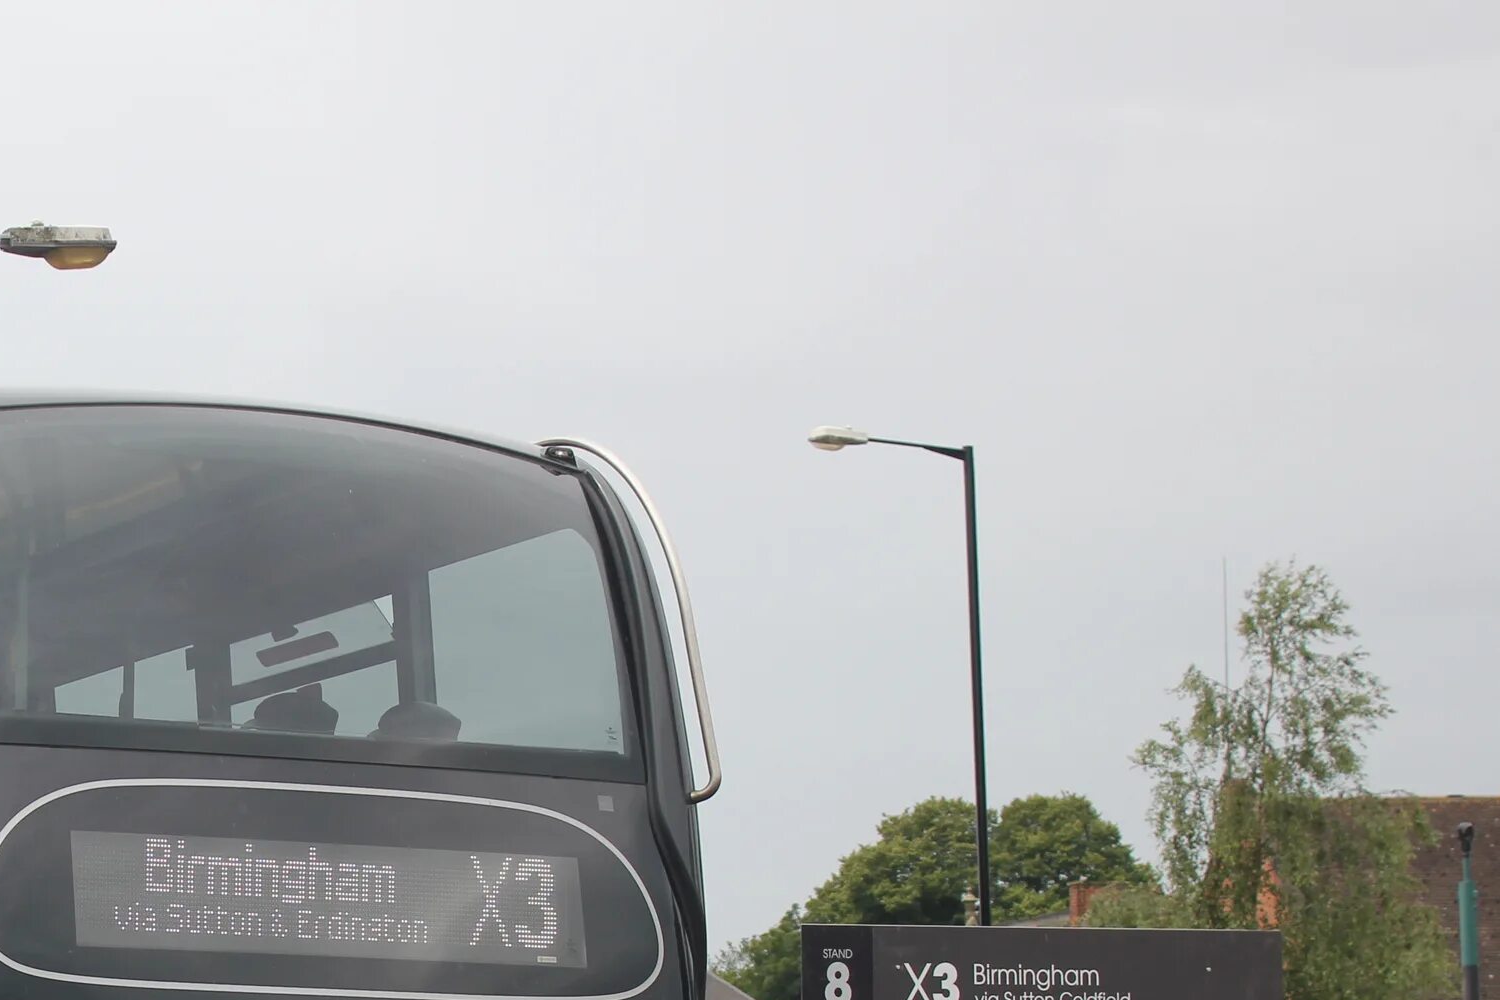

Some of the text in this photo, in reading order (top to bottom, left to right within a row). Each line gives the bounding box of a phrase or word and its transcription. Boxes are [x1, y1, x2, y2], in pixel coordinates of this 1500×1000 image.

[145, 837, 558, 948] Birmingham X3
[114, 902, 157, 931] via
[166, 904, 263, 937] Sutton
[274, 908, 289, 939] &
[822, 948, 853, 959] STAND
[973, 963, 1100, 991] Birmingham
